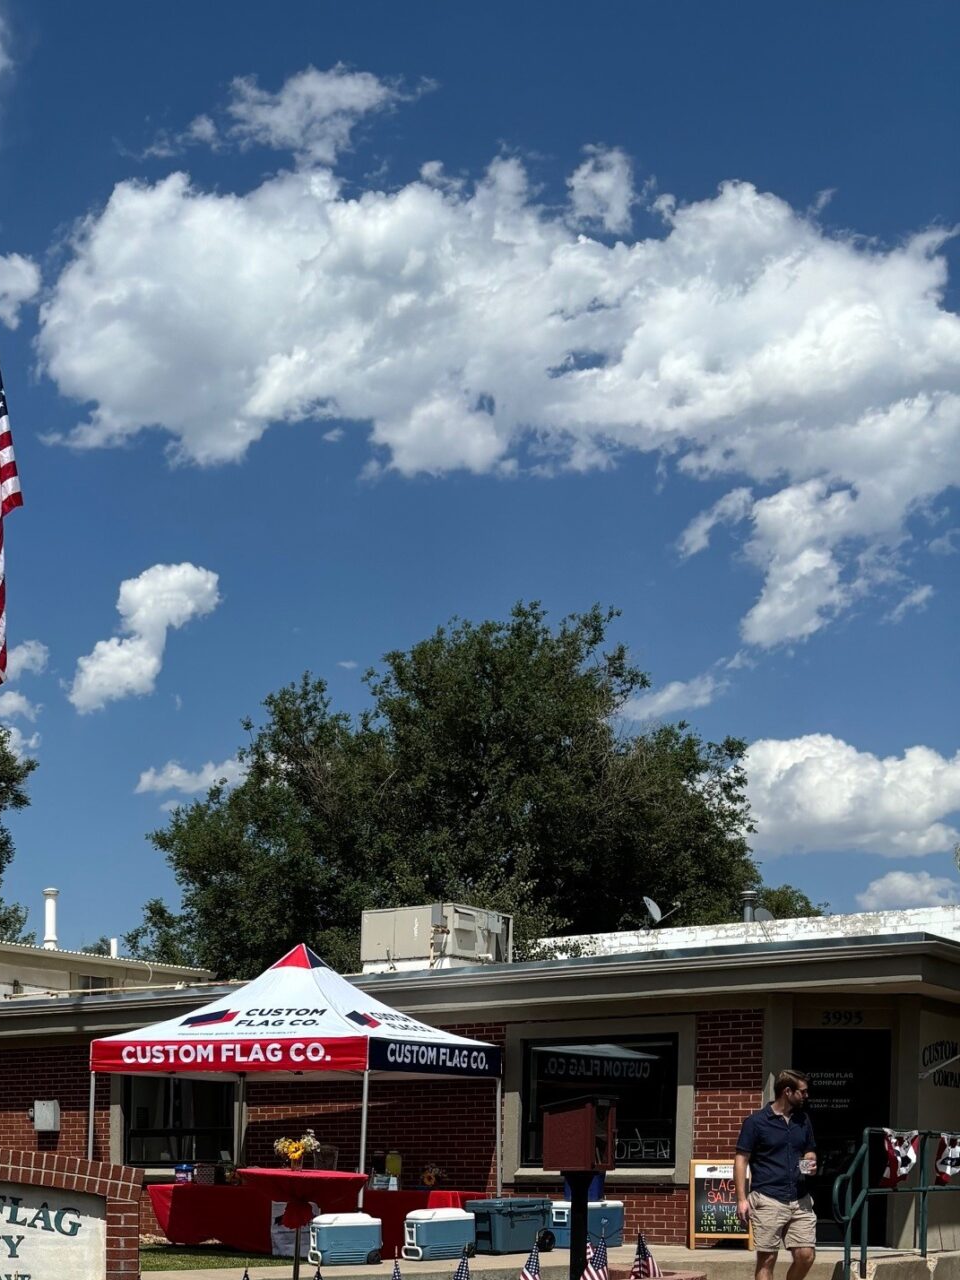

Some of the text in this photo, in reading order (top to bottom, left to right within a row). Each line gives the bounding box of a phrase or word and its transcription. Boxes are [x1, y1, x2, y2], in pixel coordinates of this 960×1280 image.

[245, 1008, 327, 1017] CUSTOM
[369, 1011, 413, 1023] CUSTOM
[821, 1010, 863, 1025] 3995
[235, 1018, 320, 1028] FLAG CO.
[122, 1042, 331, 1064] CUSTOM FLAG CO.
[387, 1043, 489, 1070] CUSTOM FLAG CO.
[922, 1039, 958, 1067] CUSTOM
[933, 1069, 960, 1089] COMPA
[615, 1138, 670, 1160] OPEN
[704, 1178, 736, 1191] FLAG
[708, 1191, 737, 1203] SALE
[701, 1204, 717, 1213] USA
